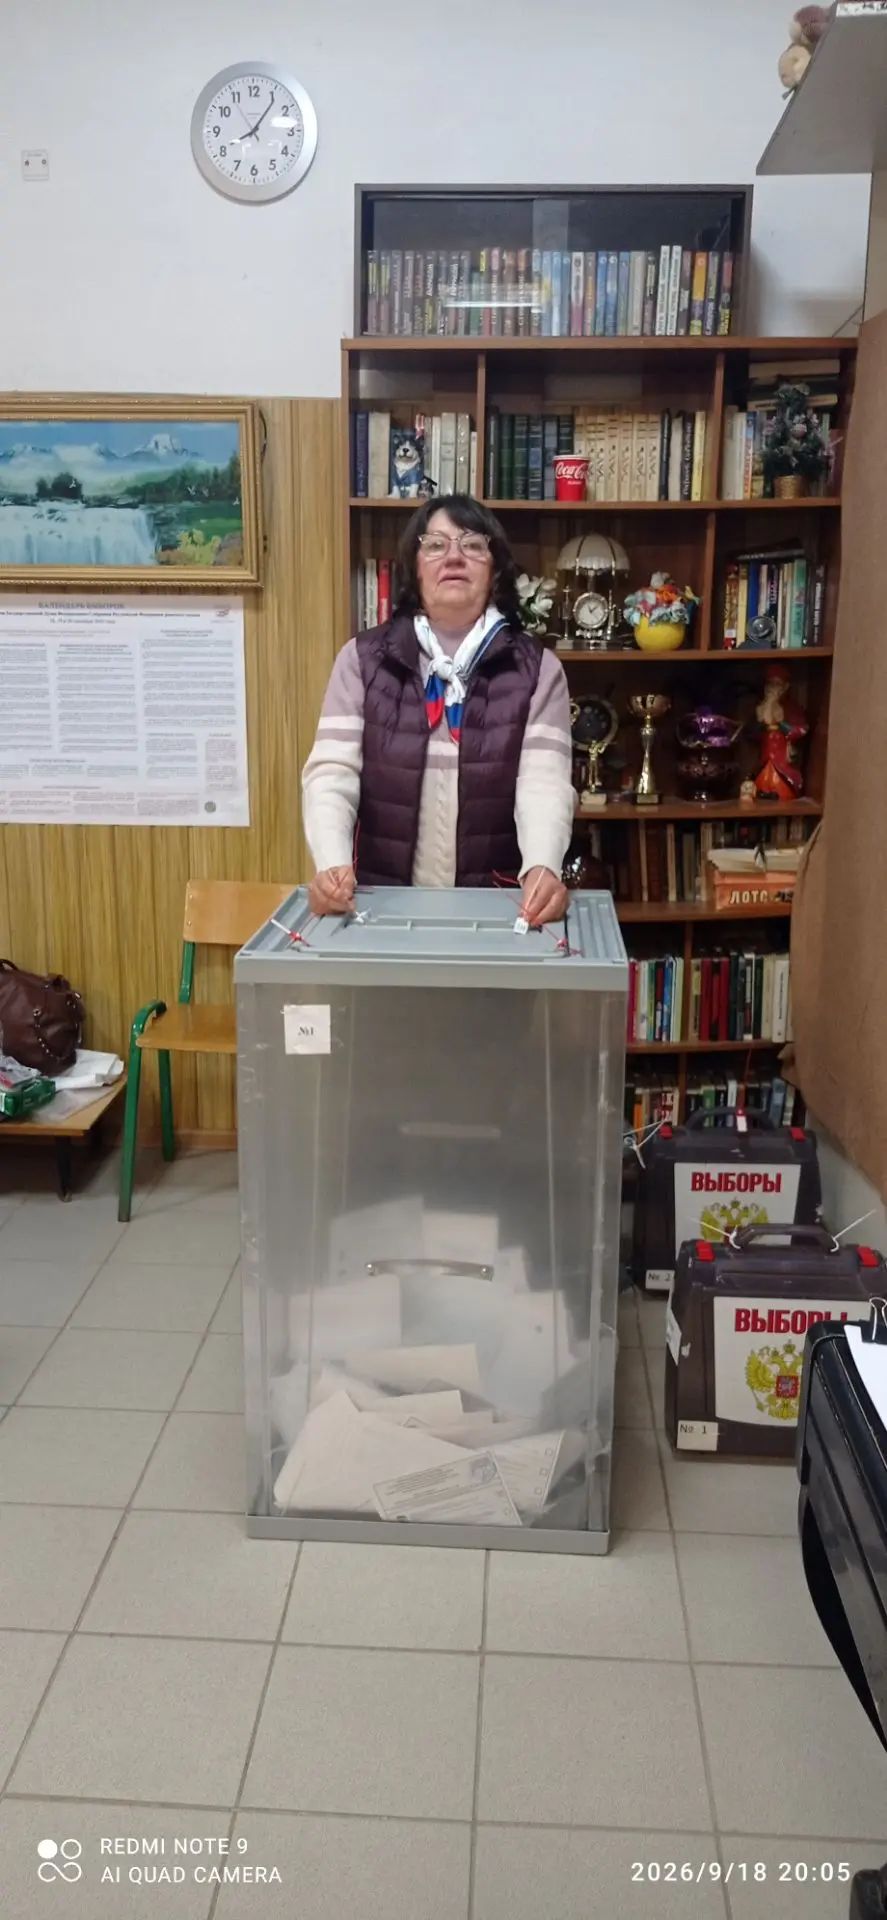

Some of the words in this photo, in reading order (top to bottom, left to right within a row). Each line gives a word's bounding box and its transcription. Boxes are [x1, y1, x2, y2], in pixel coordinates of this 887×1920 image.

[231, 91, 241, 103] 11
[248, 85, 260, 98] 12
[218, 106, 231, 118] 10
[281, 105, 289, 117] 2
[213, 126, 221, 137] 9
[287, 126, 295, 137] 3
[219, 145, 227, 157] 8
[281, 145, 289, 157] 4
[234, 160, 241, 171] 7
[250, 164, 258, 176] 6
[269, 159, 277, 171] 5
[691, 1171, 782, 1193] ВЫБОРЫ
